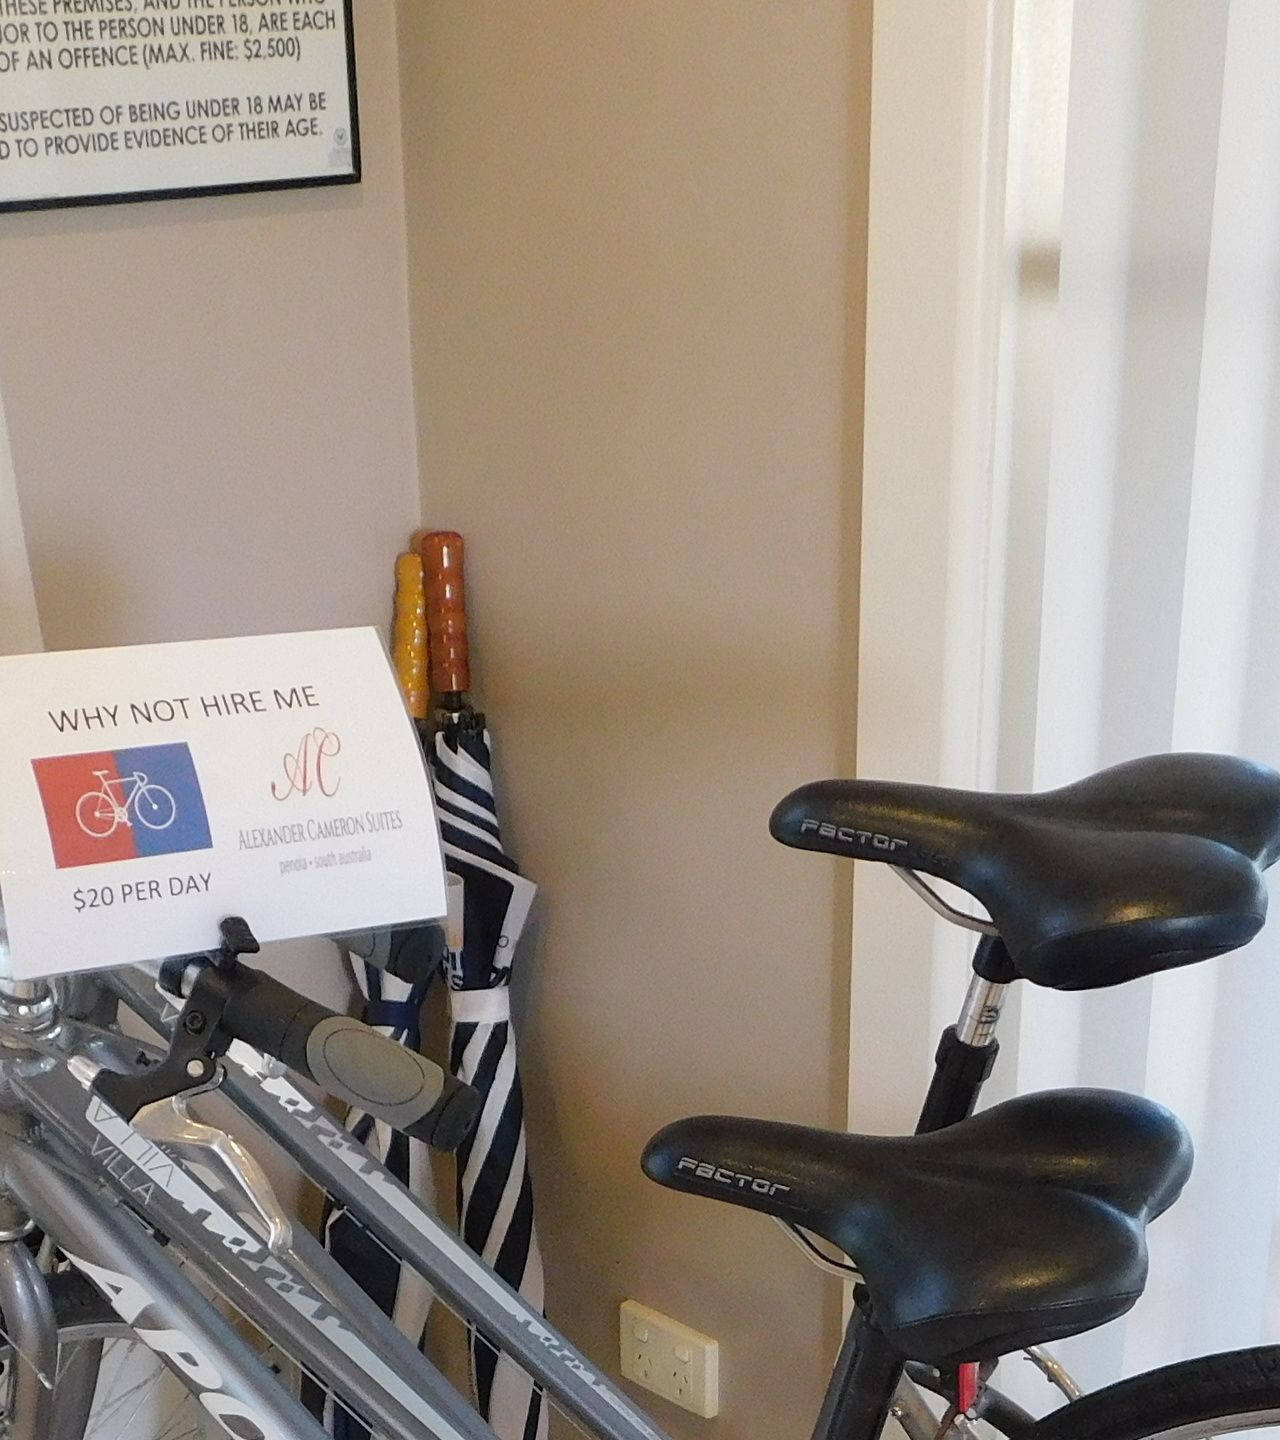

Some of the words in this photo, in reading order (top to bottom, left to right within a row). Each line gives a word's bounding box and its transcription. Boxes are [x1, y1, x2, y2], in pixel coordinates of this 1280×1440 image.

[35, 21, 58, 43] TO
[63, 20, 94, 42] THE
[99, 17, 165, 40] PERSON
[170, 15, 226, 37] UNDER
[231, 13, 253, 36] 18,
[258, 12, 289, 33] ARE
[292, 10, 336, 31] EACH
[26, 49, 53, 71] AN
[58, 45, 138, 70] OFFENCE
[142, 43, 195, 70] (MAX.
[200, 40, 239, 62] FINE:
[243, 36, 301, 62] $2,500)
[99, 105, 123, 125] OF
[128, 101, 181, 123] BEING
[185, 97, 241, 119] UNDER
[246, 95, 263, 115] 18
[269, 93, 303, 113] MAY
[308, 91, 327, 111] BE
[15, 138, 39, 158] TO
[44, 132, 119, 156] PROVIDE
[124, 125, 208, 150] EVIDENCE
[211, 123, 235, 144] OF
[238, 120, 280, 141] THEIR
[284, 117, 323, 138] AGE.
[48, 704, 119, 733] WHY
[130, 697, 190, 724] NOT
[200, 690, 267, 718] HIRE
[273, 685, 320, 710] ME
[73, 887, 115, 913] $20
[121, 879, 163, 904] PER
[169, 872, 212, 896] DAY
[90, 1132, 155, 1206] VILLA
